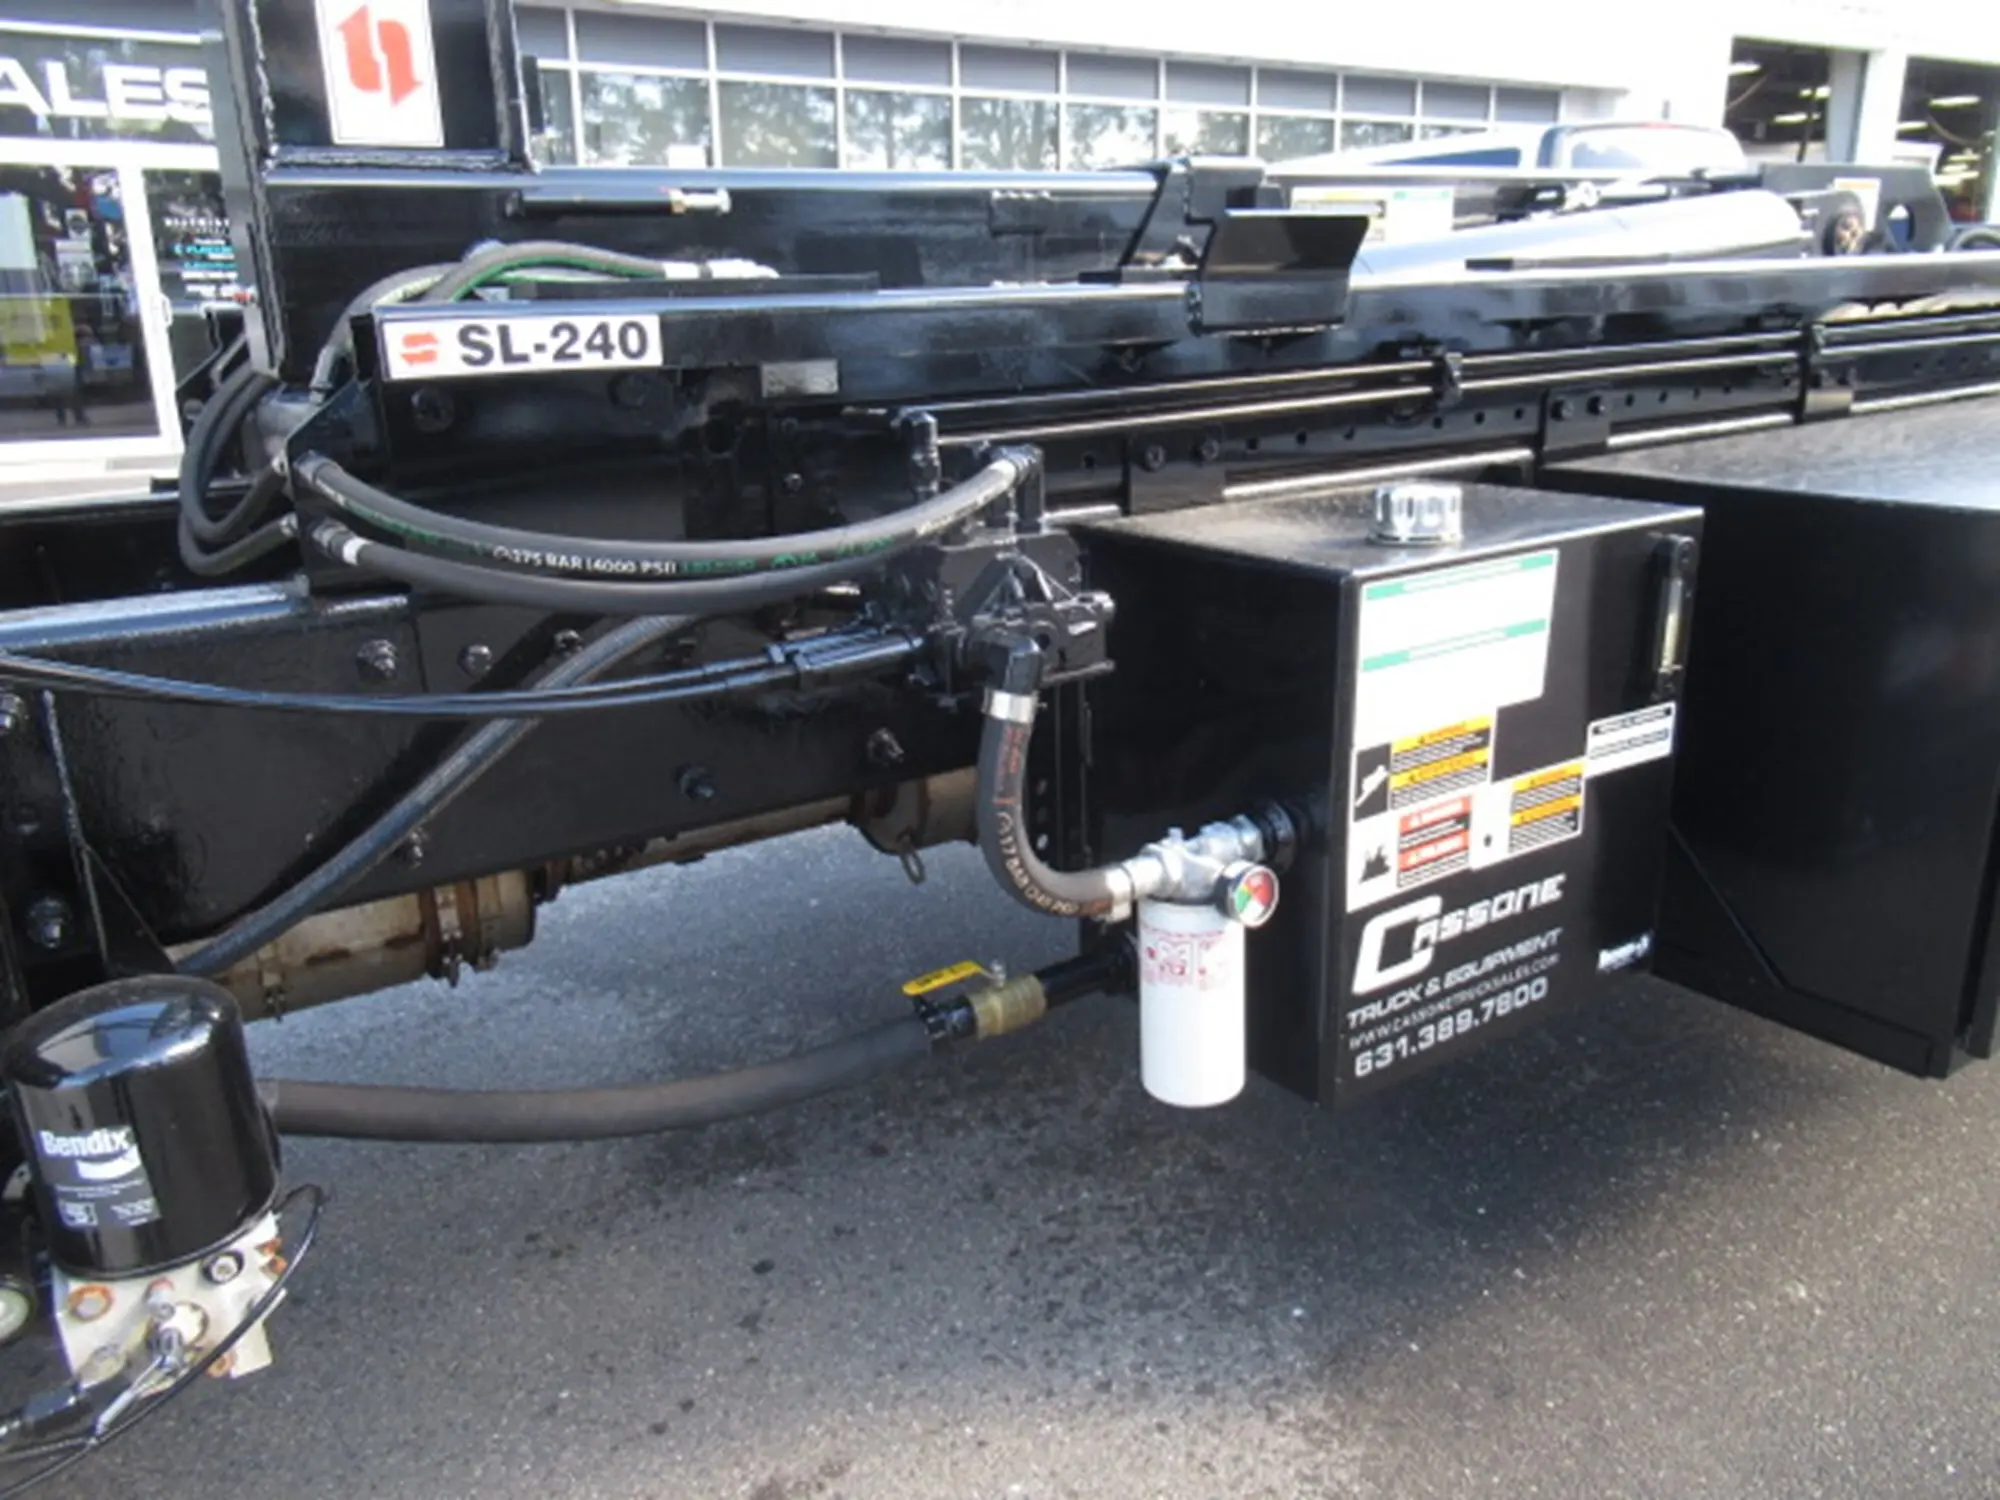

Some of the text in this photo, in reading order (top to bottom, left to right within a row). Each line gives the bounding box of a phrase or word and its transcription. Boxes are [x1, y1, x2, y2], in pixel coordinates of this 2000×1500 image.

[457, 320, 648, 367] SL-240
[1346, 982, 1423, 1030] TRUCK
[1443, 926, 1564, 990] EQUIPMENT
[1354, 976, 1549, 1077] 631.389.7800
[38, 1125, 132, 1156] Bendix
